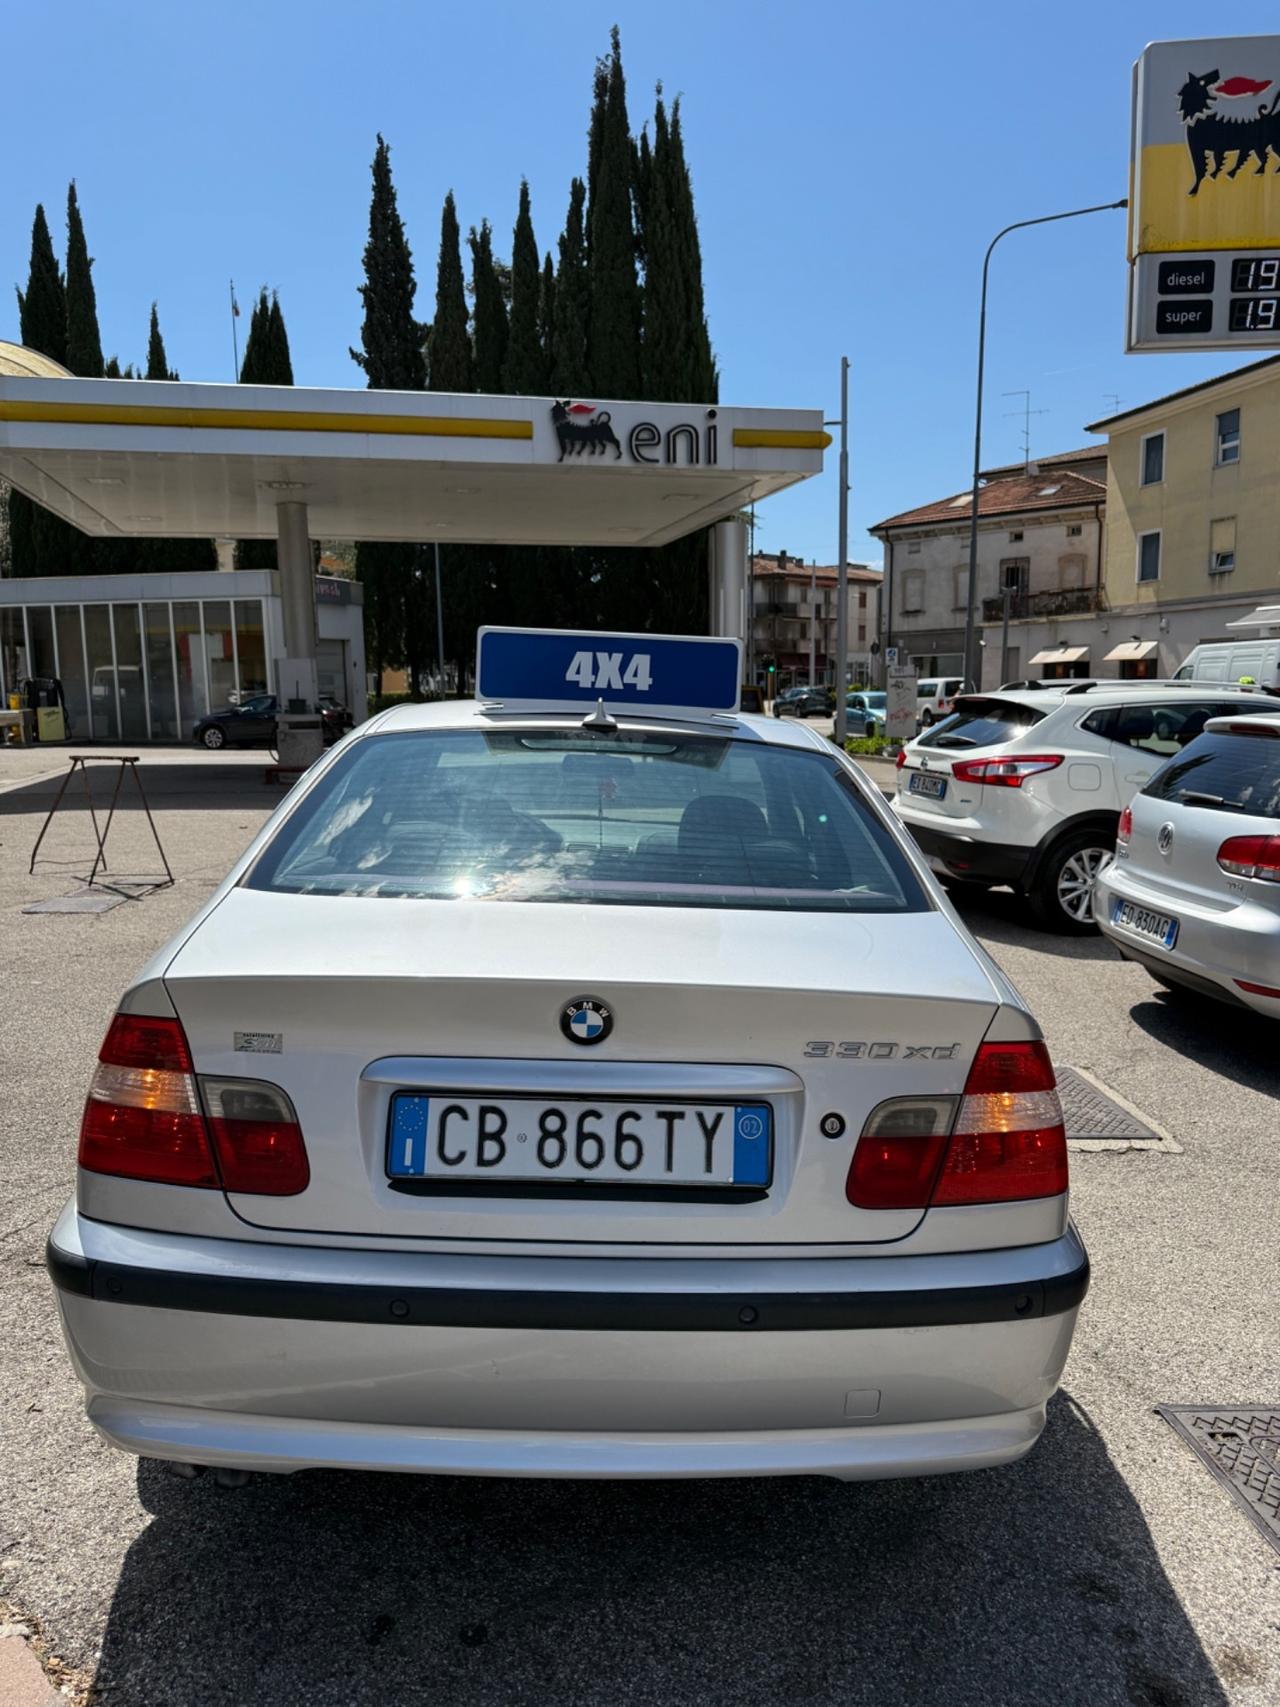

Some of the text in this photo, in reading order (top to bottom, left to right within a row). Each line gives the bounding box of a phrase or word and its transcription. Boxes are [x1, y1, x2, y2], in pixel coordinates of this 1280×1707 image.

[1167, 272, 1204, 286] diesel
[1165, 312, 1202, 325] super
[629, 408, 717, 464] eni
[565, 651, 653, 690] 4X4
[1120, 904, 1169, 939] ED 830AG
[567, 1001, 609, 1018] BMW
[437, 1104, 508, 1167] CB
[536, 1108, 726, 1174] 866TY
